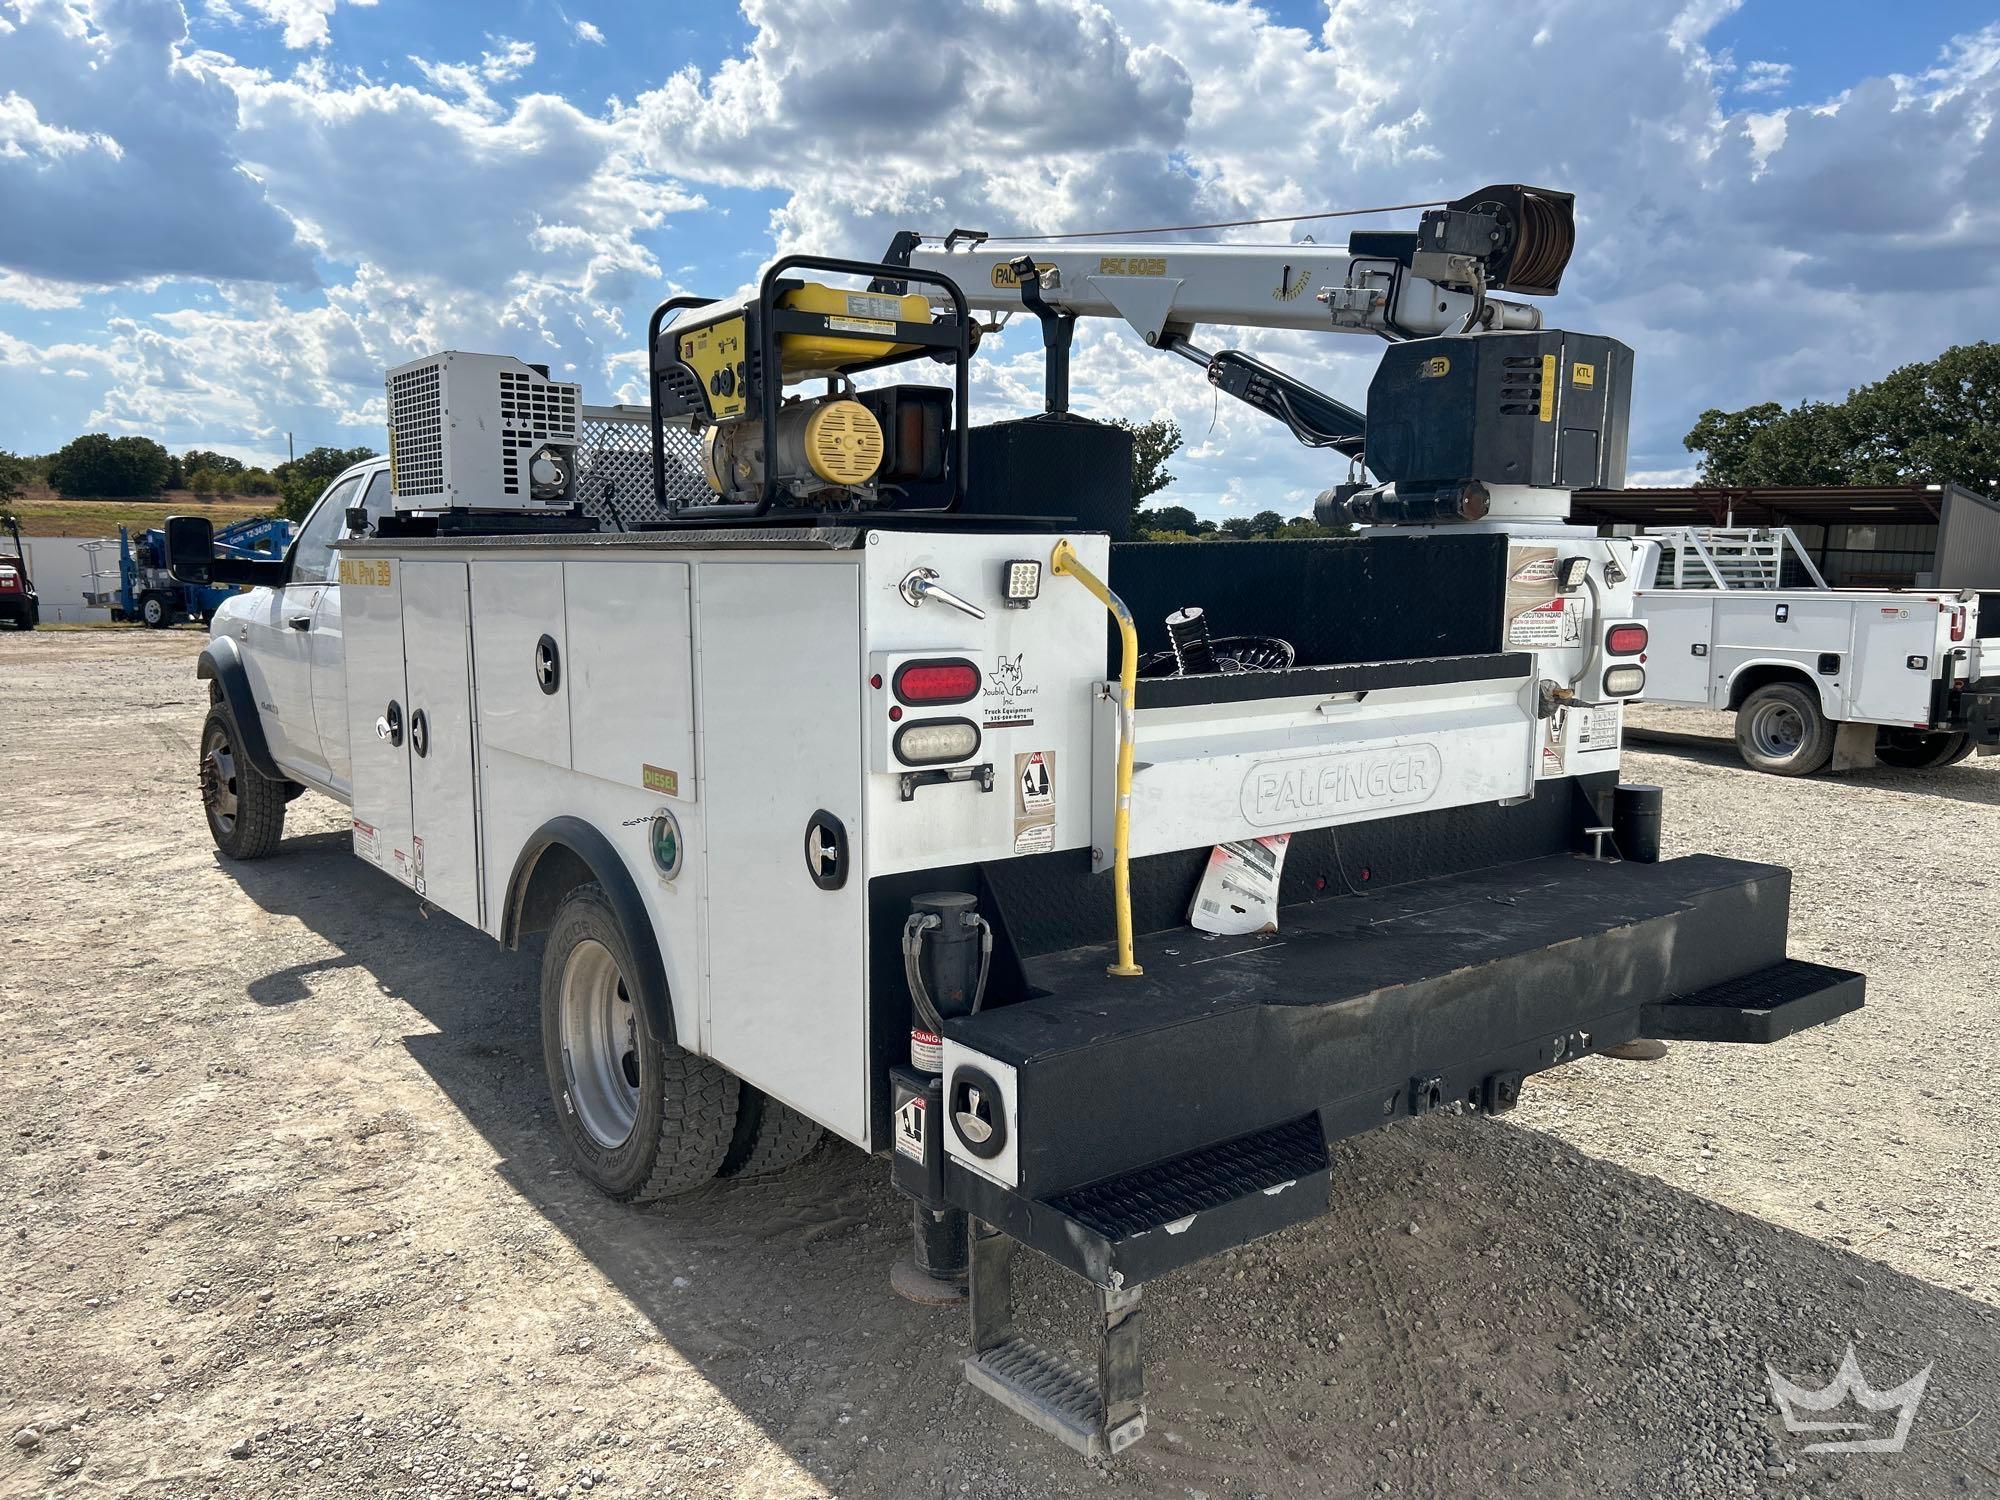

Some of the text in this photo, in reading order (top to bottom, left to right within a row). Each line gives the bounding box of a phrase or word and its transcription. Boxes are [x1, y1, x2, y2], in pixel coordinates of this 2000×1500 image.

[1100, 257, 1167, 275] PSC 6025
[1576, 366, 1591, 378] KTL
[1016, 685, 1038, 696] Barrel
[1002, 707, 1033, 715] Equipment
[644, 770, 677, 790] DIESEL
[1256, 755, 1427, 814] PALFINGER
